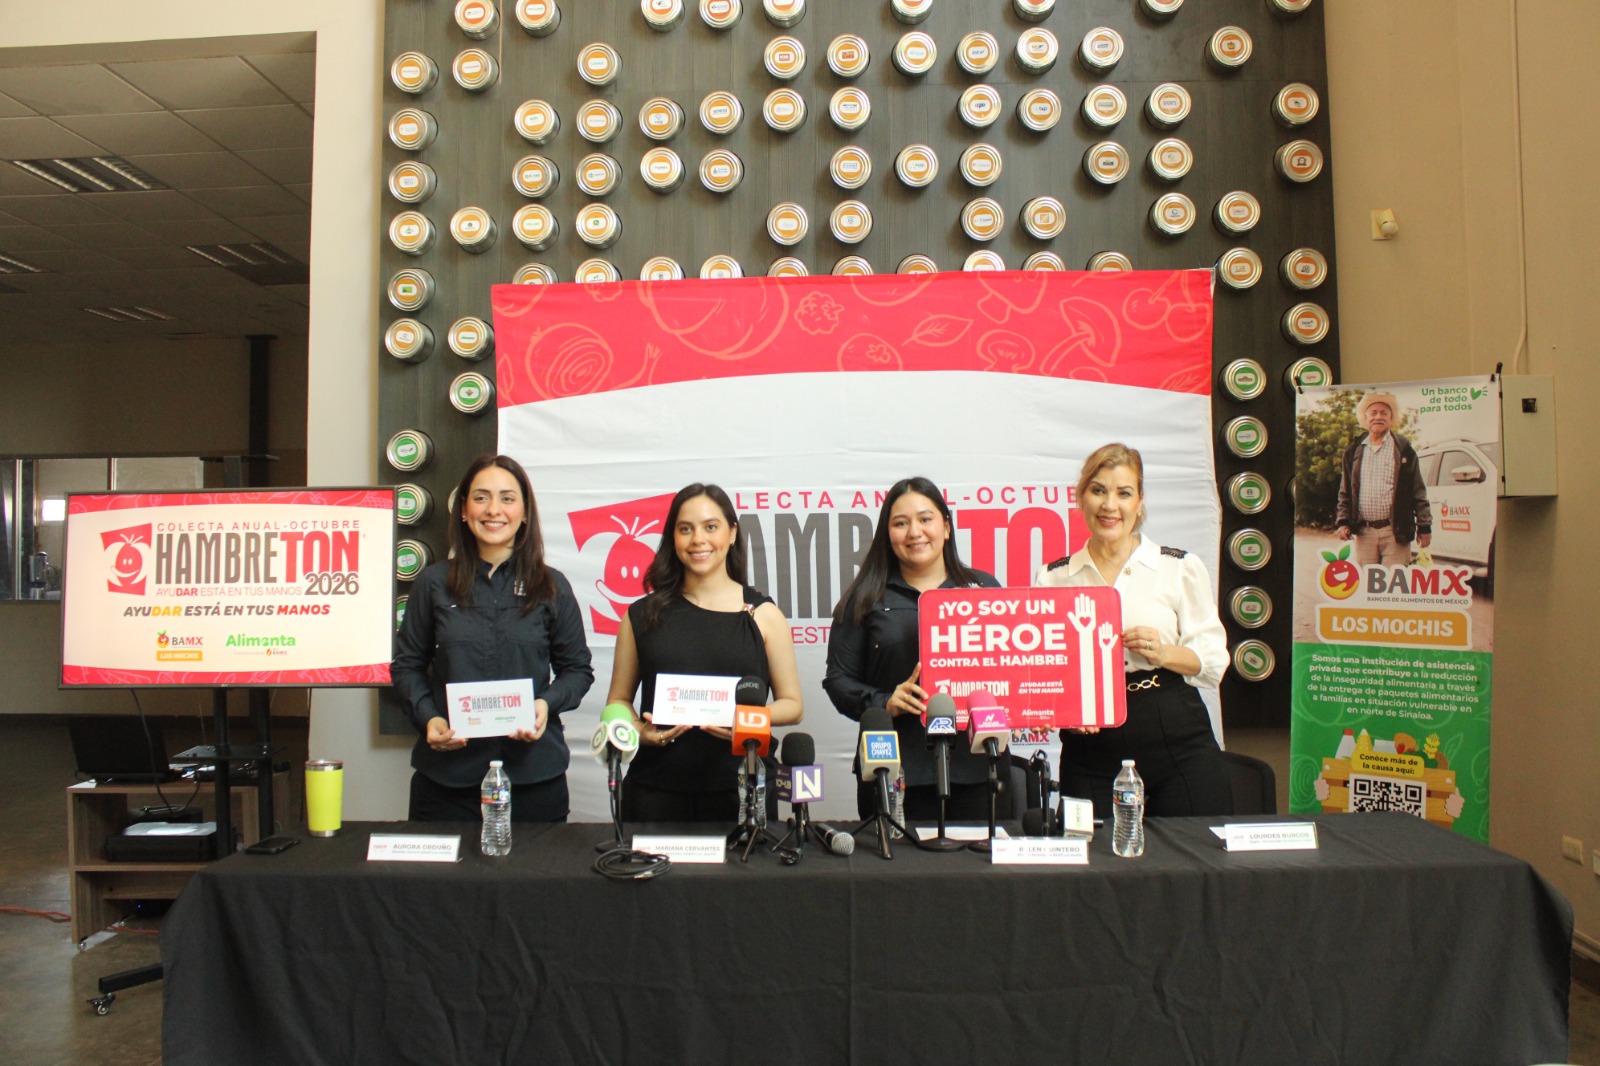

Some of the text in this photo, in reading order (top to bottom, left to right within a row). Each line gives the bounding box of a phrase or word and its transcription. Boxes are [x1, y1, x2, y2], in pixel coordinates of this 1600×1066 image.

[1421, 386, 1468, 396] Un banco
[1429, 394, 1468, 404] de todo
[1420, 402, 1472, 415] para todos
[735, 491, 834, 510] LECTA
[156, 522, 225, 532] COLECTA
[155, 530, 361, 585] HAMBRETON
[156, 585, 303, 597] AYUDAR ESTÁ EN TUS MANOS
[304, 572, 360, 596] 2026
[1367, 568, 1469, 597] BAMX
[123, 602, 331, 617] AYUDAR ESTÁ EN TUS MANOS
[938, 599, 1056, 619] ¡YO SOY UN
[791, 626, 832, 644] EST
[930, 617, 1068, 653] HÉROE
[1332, 616, 1454, 637] LOS MOCHIS
[171, 636, 204, 646] BAMX
[929, 653, 1069, 668] CONTRA EL HAMBRE!
[1312, 654, 1341, 662] Somos
[1362, 657, 1411, 668] institución
[1413, 660, 1425, 668] de
[1427, 661, 1475, 671] asistencia
[1309, 664, 1342, 673] privada
[1344, 667, 1360, 675] que
[1362, 667, 1411, 678] contribuye
[1421, 671, 1429, 679] la
[1431, 672, 1478, 682] reducción
[1046, 680, 1064, 688] ESTÁ
[1323, 674, 1331, 682] la
[1332, 675, 1384, 686] inseguridad
[1386, 678, 1437, 690] alimentaria
[1447, 683, 1476, 692] través
[678, 687, 729, 702] HAMBRETON
[1307, 683, 1318, 691] de
[1329, 686, 1363, 695] entrega
[1365, 687, 1376, 695] de
[1378, 689, 1420, 699] paquetes
[1421, 692, 1479, 703] alimentarios
[472, 694, 522, 711] HAMBRETON
[1320, 694, 1353, 703] familias
[1368, 697, 1407, 708] situación
[1409, 701, 1458, 712] vulnerable
[1360, 707, 1384, 716] norte
[1386, 709, 1397, 717] de
[1398, 710, 1434, 720] Sinaloa.
[1371, 764, 1394, 772] causa
[422, 843, 452, 851] ORDUÑO
